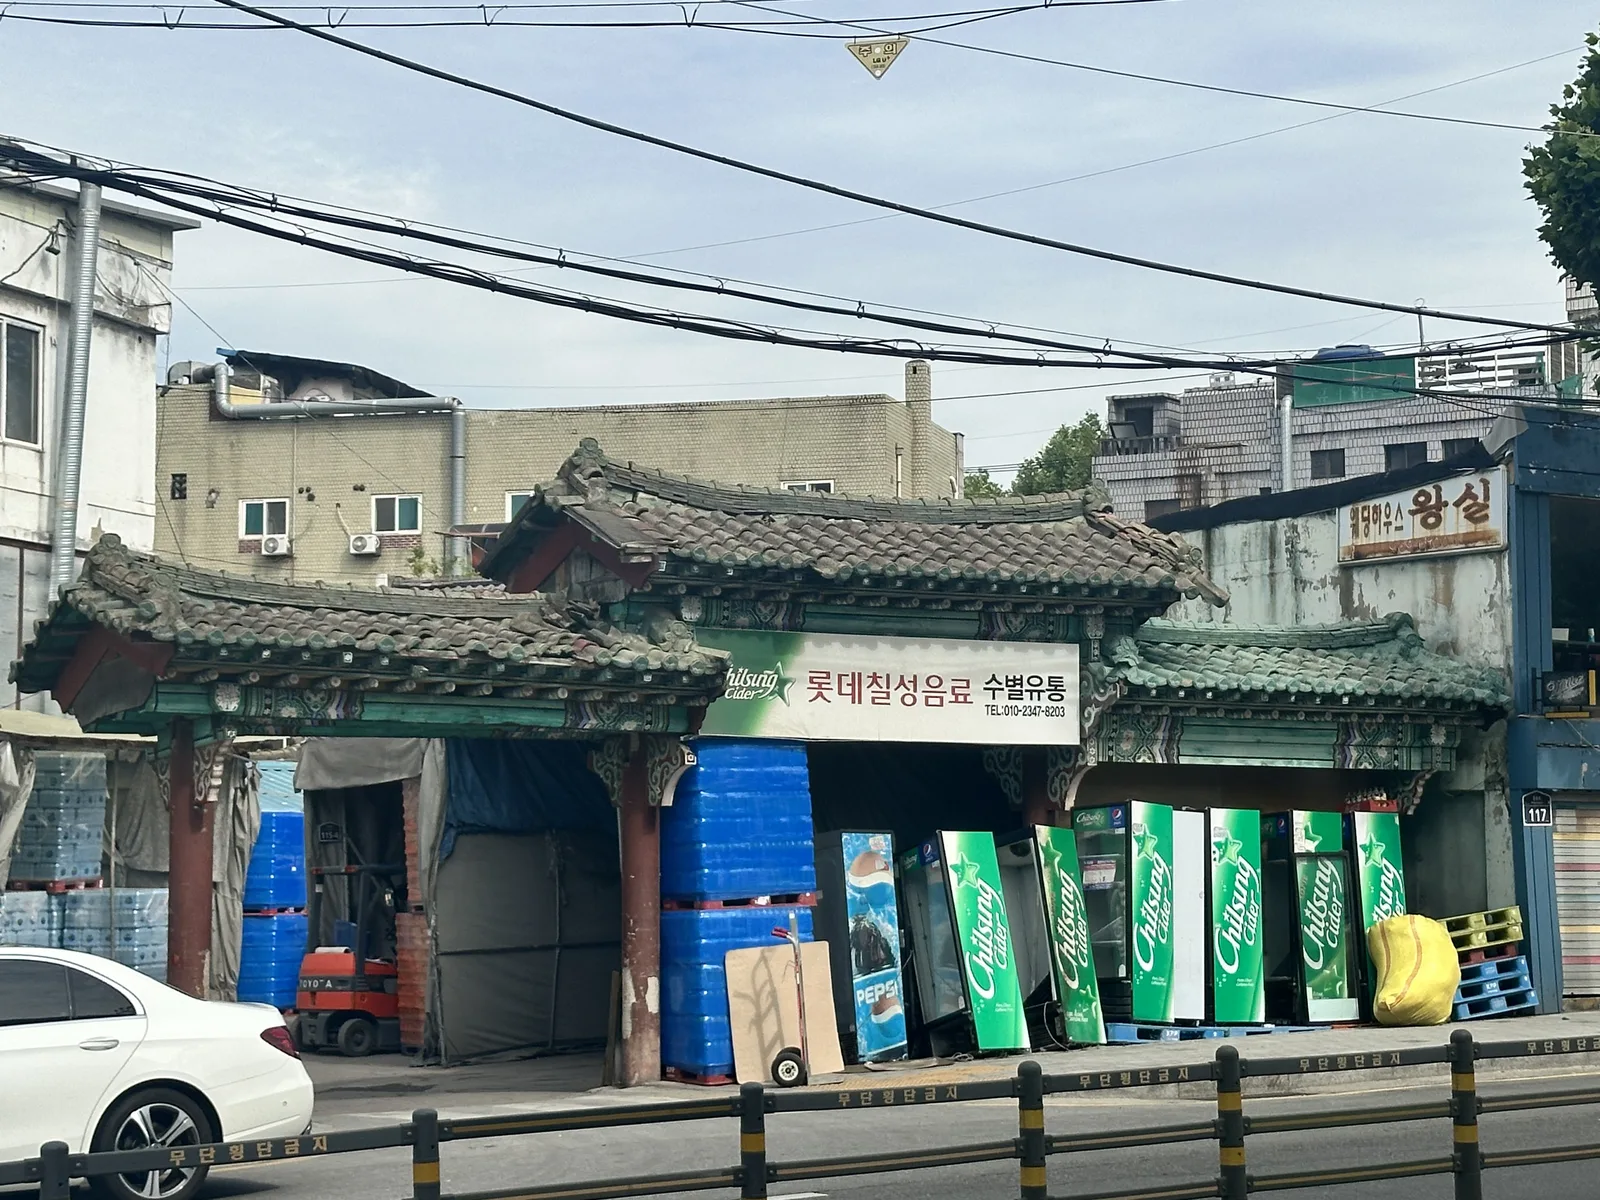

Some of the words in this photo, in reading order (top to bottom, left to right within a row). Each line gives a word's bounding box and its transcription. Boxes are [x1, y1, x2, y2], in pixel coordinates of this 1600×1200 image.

[859, 42, 897, 57] 주의
[1408, 477, 1491, 530] 왕실
[724, 687, 764, 700] Cider
[726, 665, 779, 699] hilsung
[806, 669, 974, 706] 롯데칠성음료
[983, 673, 1067, 702] 수별유통
[984, 704, 1065, 718] TEL:010-2347-8203
[1528, 808, 1546, 822] 117
[965, 877, 1005, 999] Chilsung
[1055, 868, 1084, 989] Chilsung
[1076, 899, 1088, 968] Cider
[1134, 851, 1171, 972] Chilsung
[1158, 886, 1171, 944] Cider
[1215, 855, 1260, 974] Chilsung
[1243, 889, 1260, 946] Cider
[1302, 857, 1343, 970] Chilsung
[1326, 882, 1343, 948] Cider
[994, 912, 1007, 969] Cider
[856, 980, 899, 1007] PEPSI
